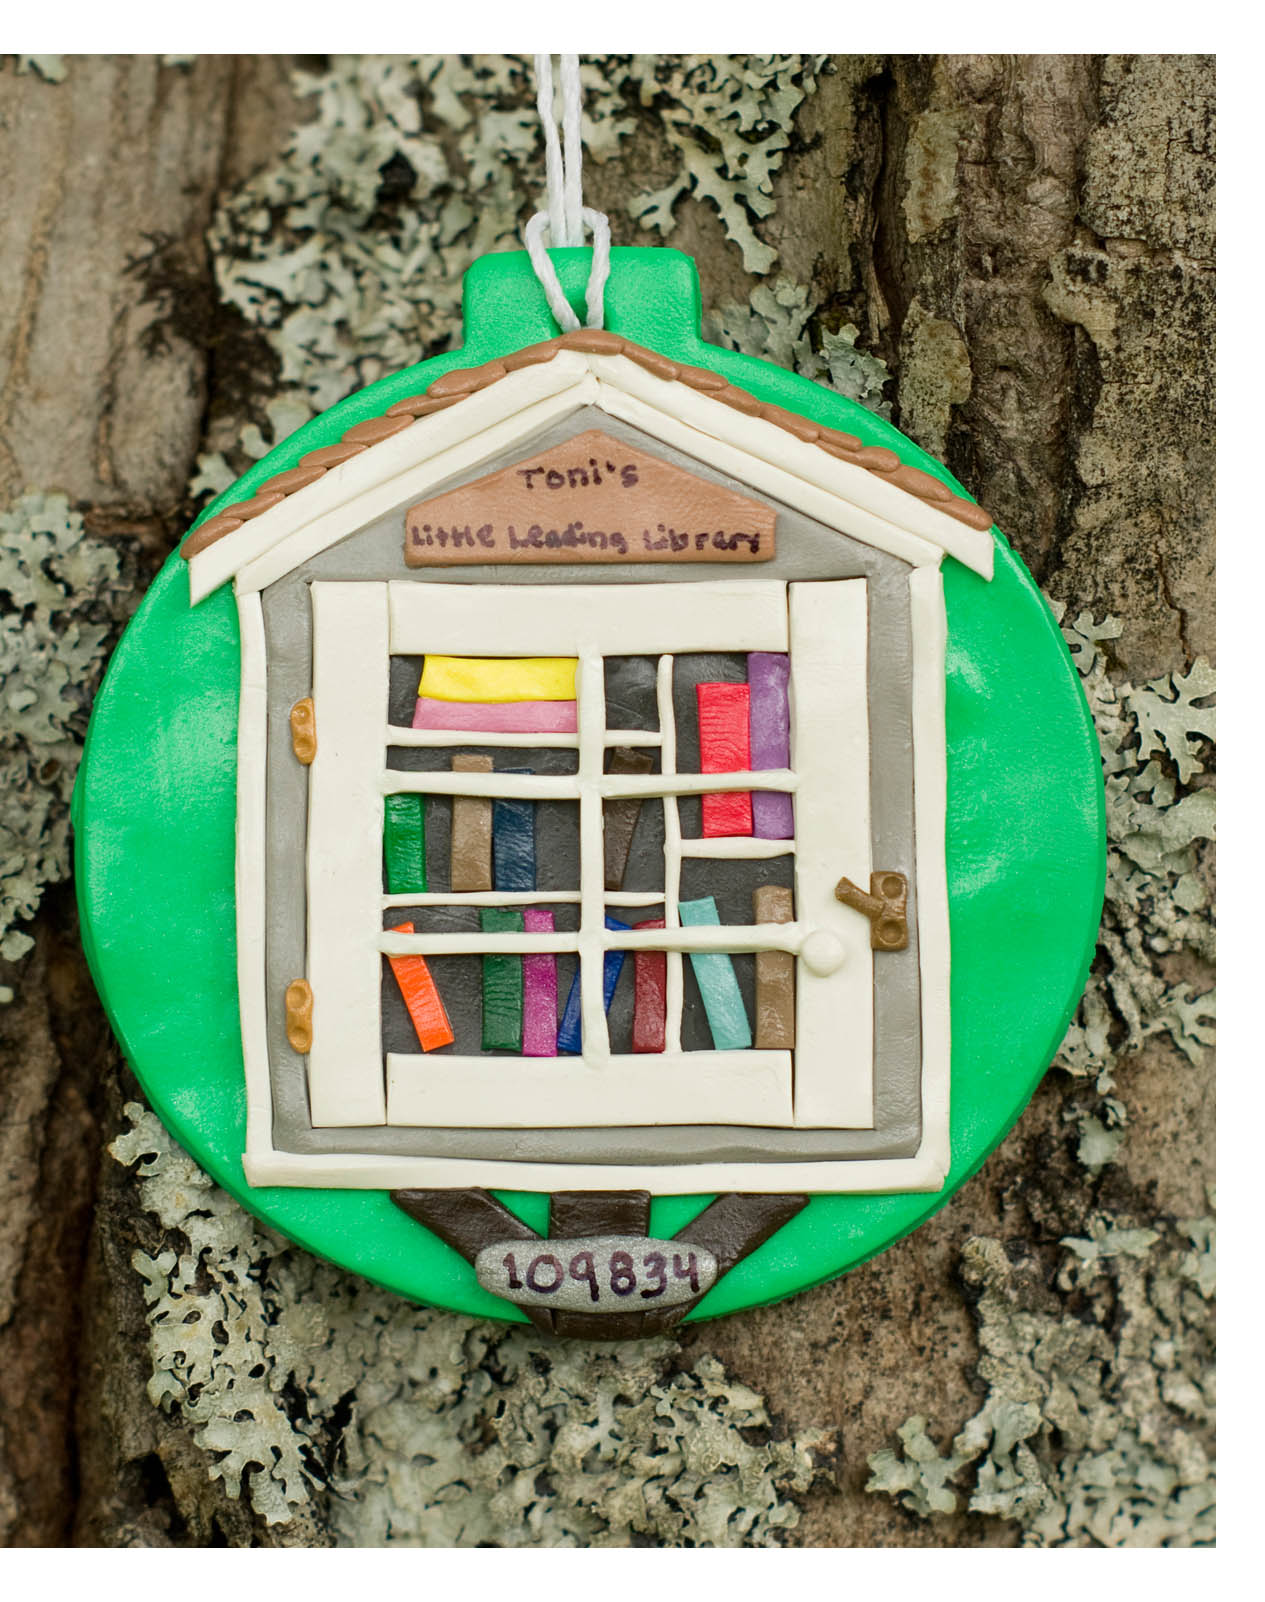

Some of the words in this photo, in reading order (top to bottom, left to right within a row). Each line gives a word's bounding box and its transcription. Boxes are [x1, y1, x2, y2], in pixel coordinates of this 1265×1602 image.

[517, 458, 640, 491] Toni's
[411, 522, 496, 549] Little
[643, 523, 761, 554] Library
[502, 1250, 701, 1302] 109834
